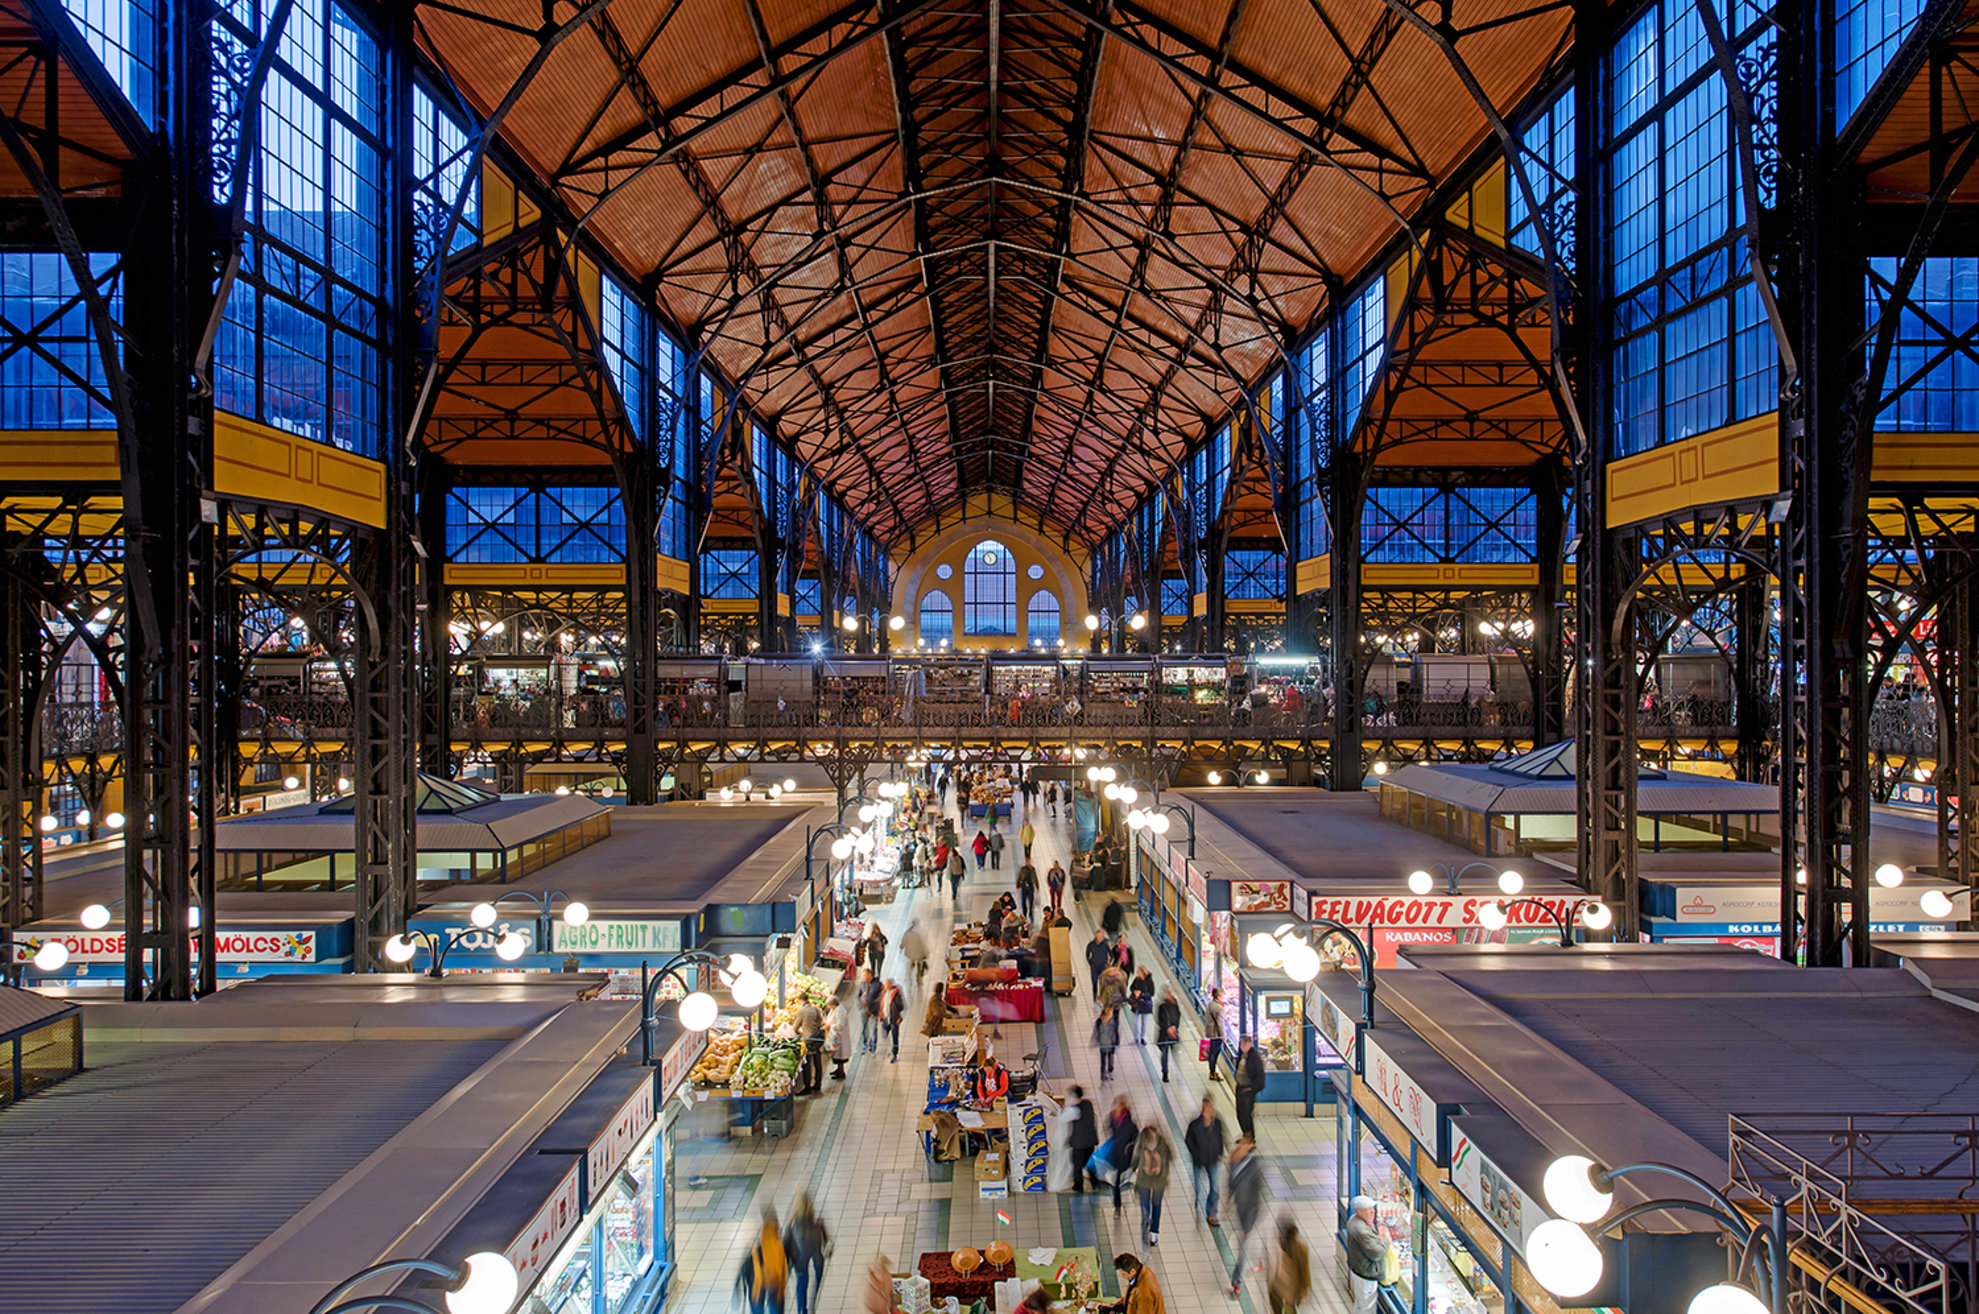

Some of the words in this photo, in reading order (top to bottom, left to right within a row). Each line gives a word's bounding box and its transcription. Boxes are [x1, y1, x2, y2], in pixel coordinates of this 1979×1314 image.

[1314, 898, 1453, 924] FELVÁGOTT
[1462, 897, 1598, 924] SKÜZLE
[558, 924, 648, 949] AGRO-FRUIT
[1385, 931, 1452, 943] KABANOS
[1392, 1072, 1403, 1113] &
